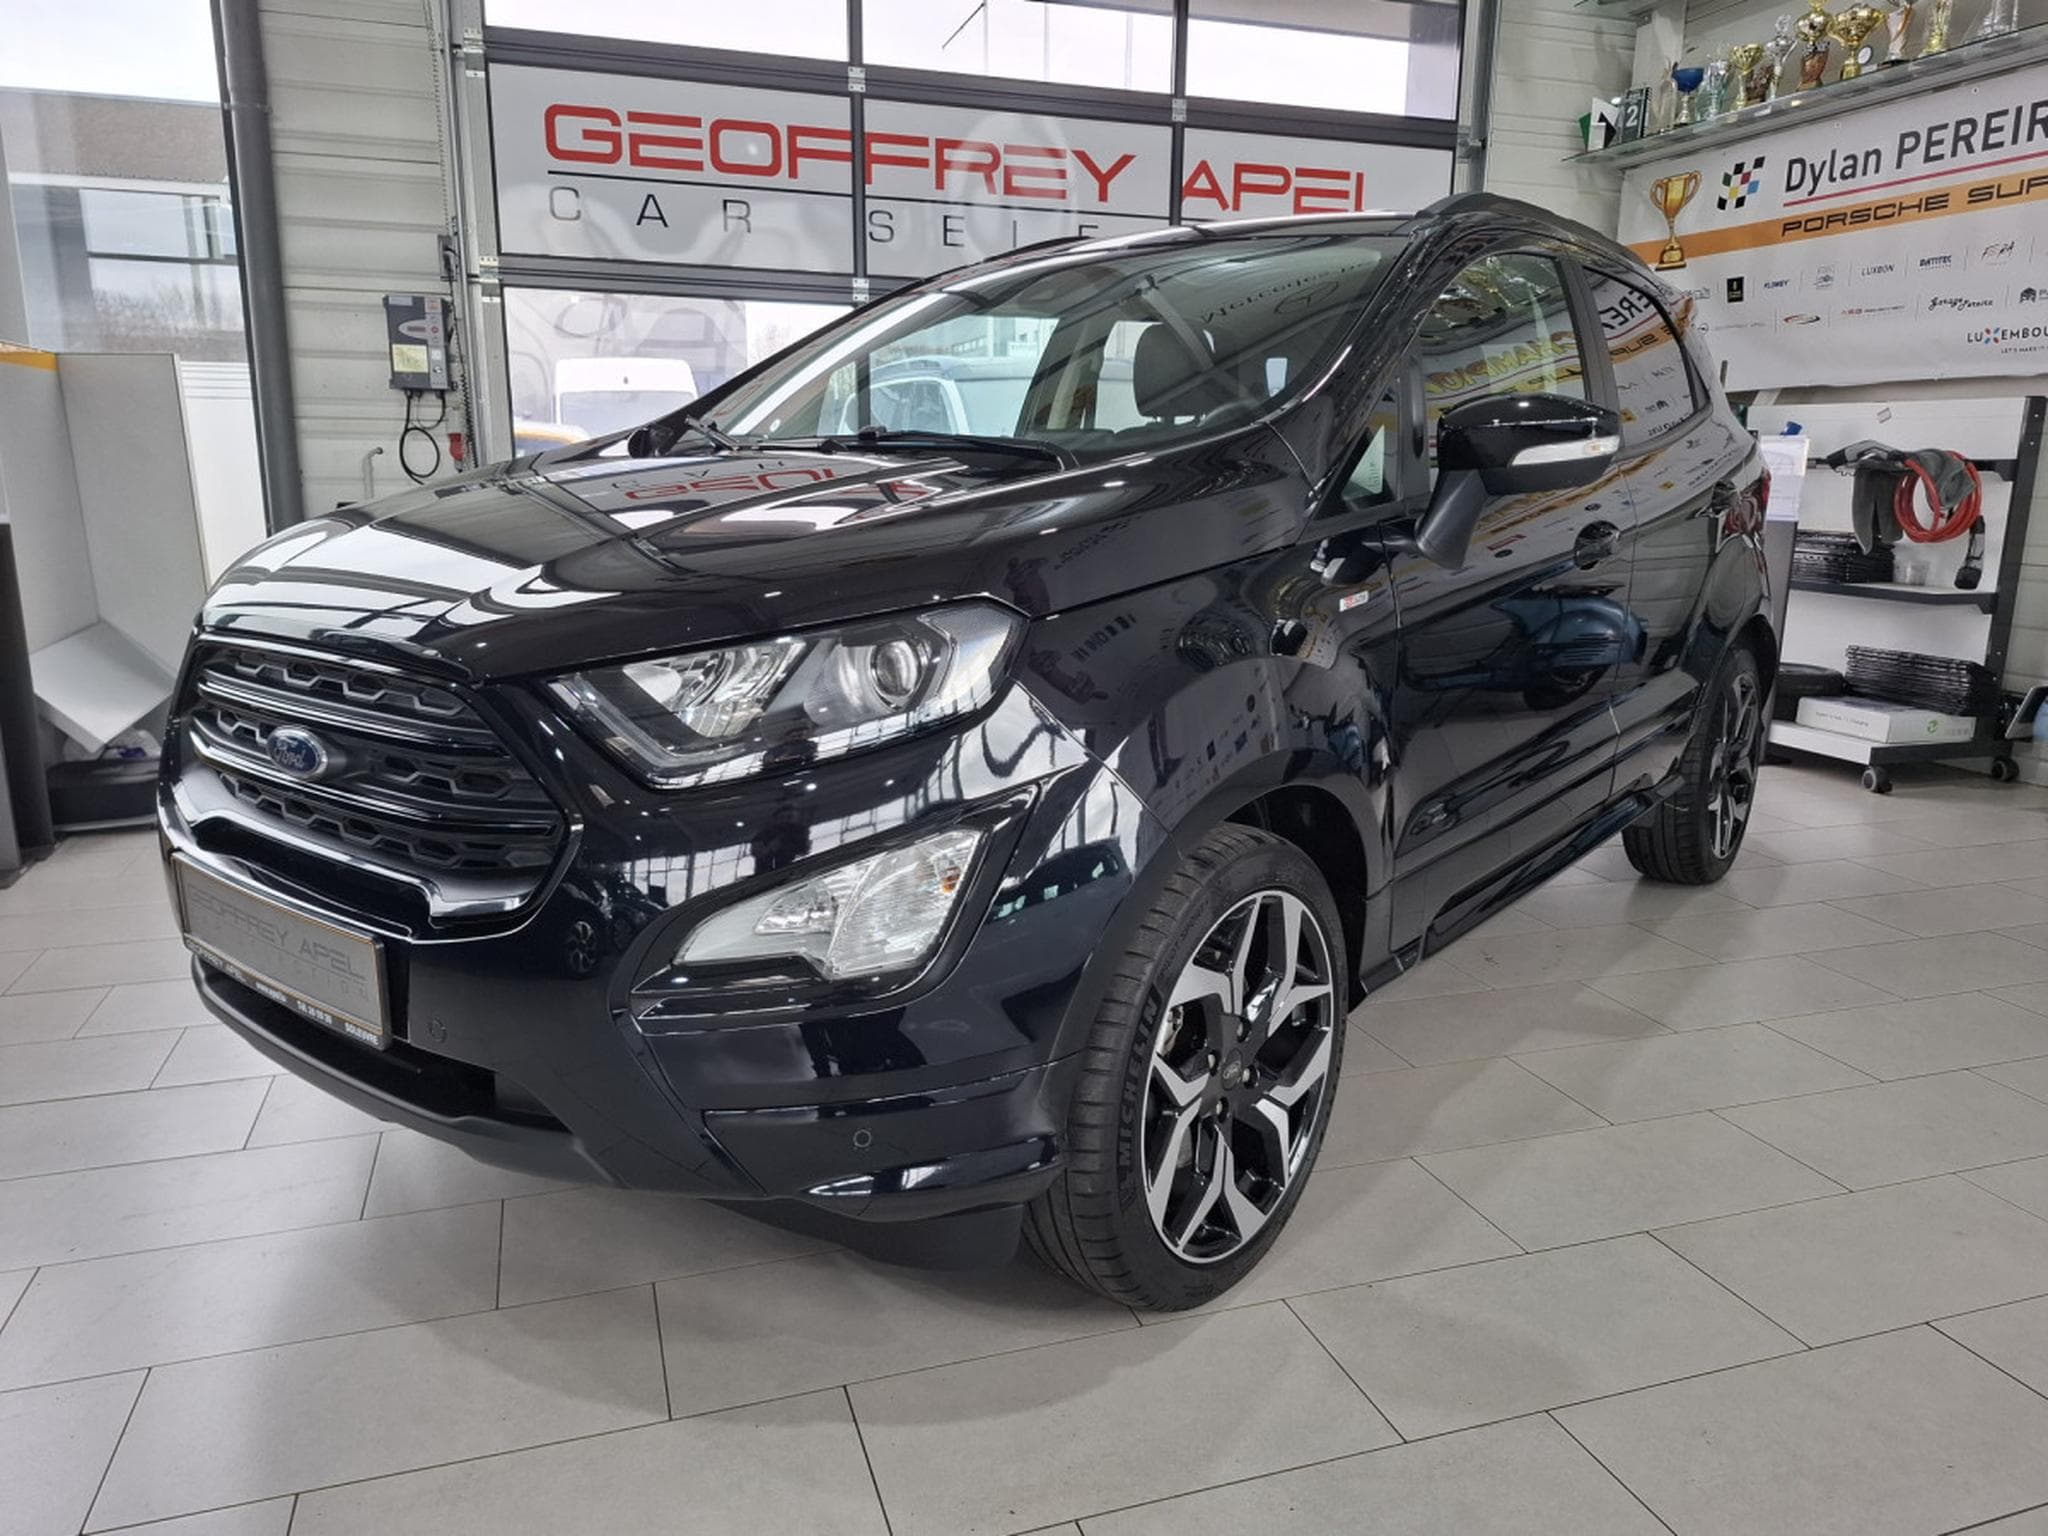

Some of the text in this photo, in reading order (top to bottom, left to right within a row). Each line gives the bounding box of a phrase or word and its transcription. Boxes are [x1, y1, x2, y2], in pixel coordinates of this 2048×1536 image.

[543, 103, 1138, 203] GEOFFREY
[1784, 148, 1883, 197] Dylan
[1781, 192, 1951, 237] PORSCHE
[273, 736, 306, 769] Ford
[1118, 983, 1163, 1167] MICHELIN
